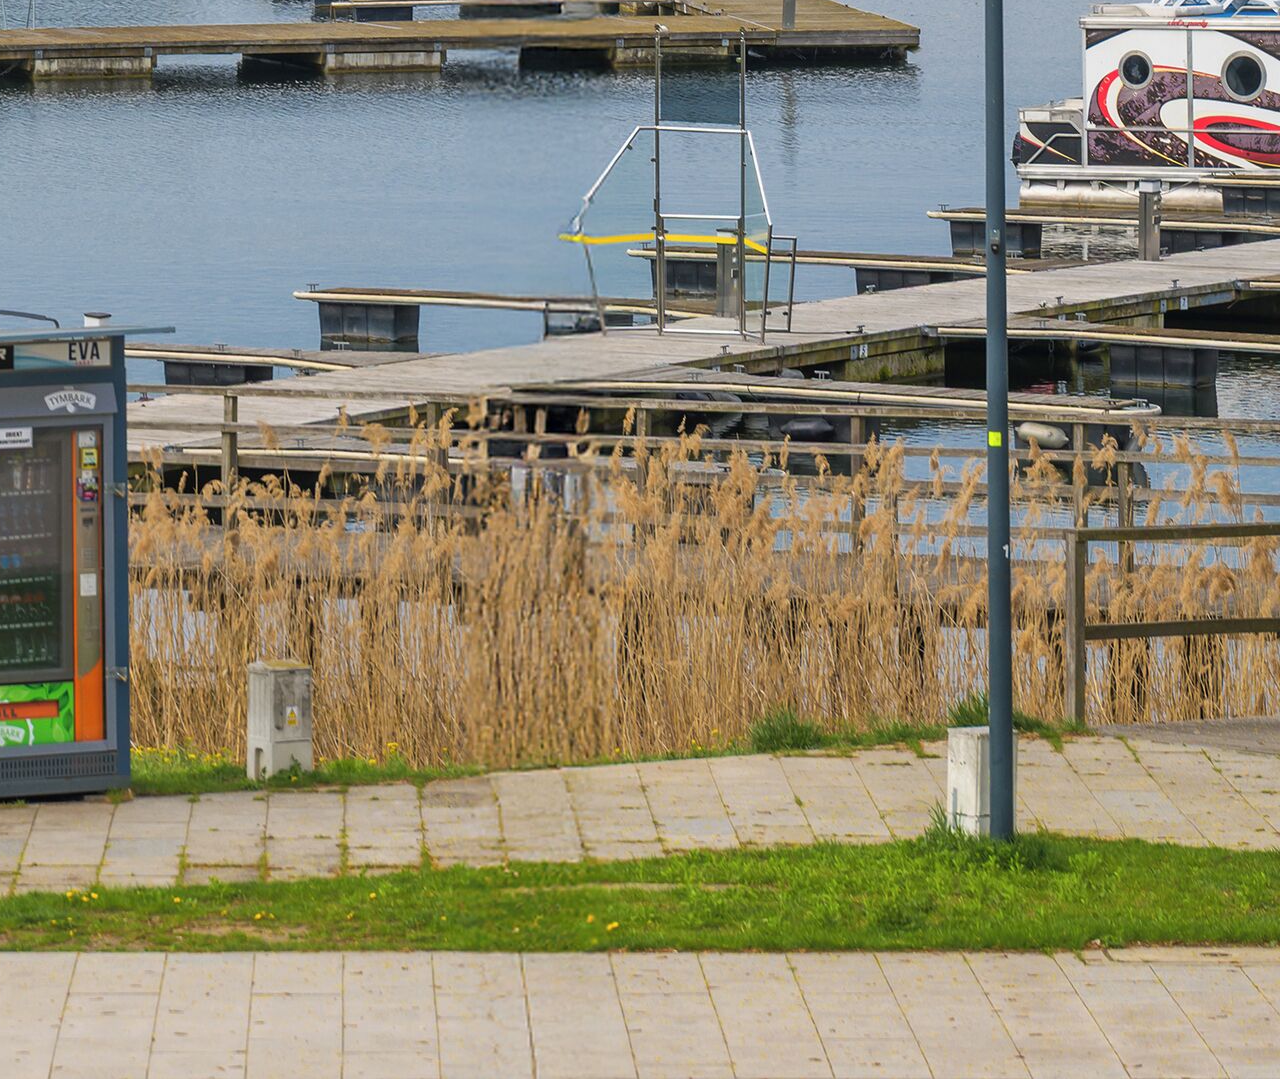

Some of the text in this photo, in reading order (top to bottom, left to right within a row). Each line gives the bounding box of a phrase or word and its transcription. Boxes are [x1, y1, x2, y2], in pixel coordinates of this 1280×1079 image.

[68, 341, 100, 361] EVA
[49, 392, 92, 406] TYMBARK
[1002, 544, 1008, 559] 1
